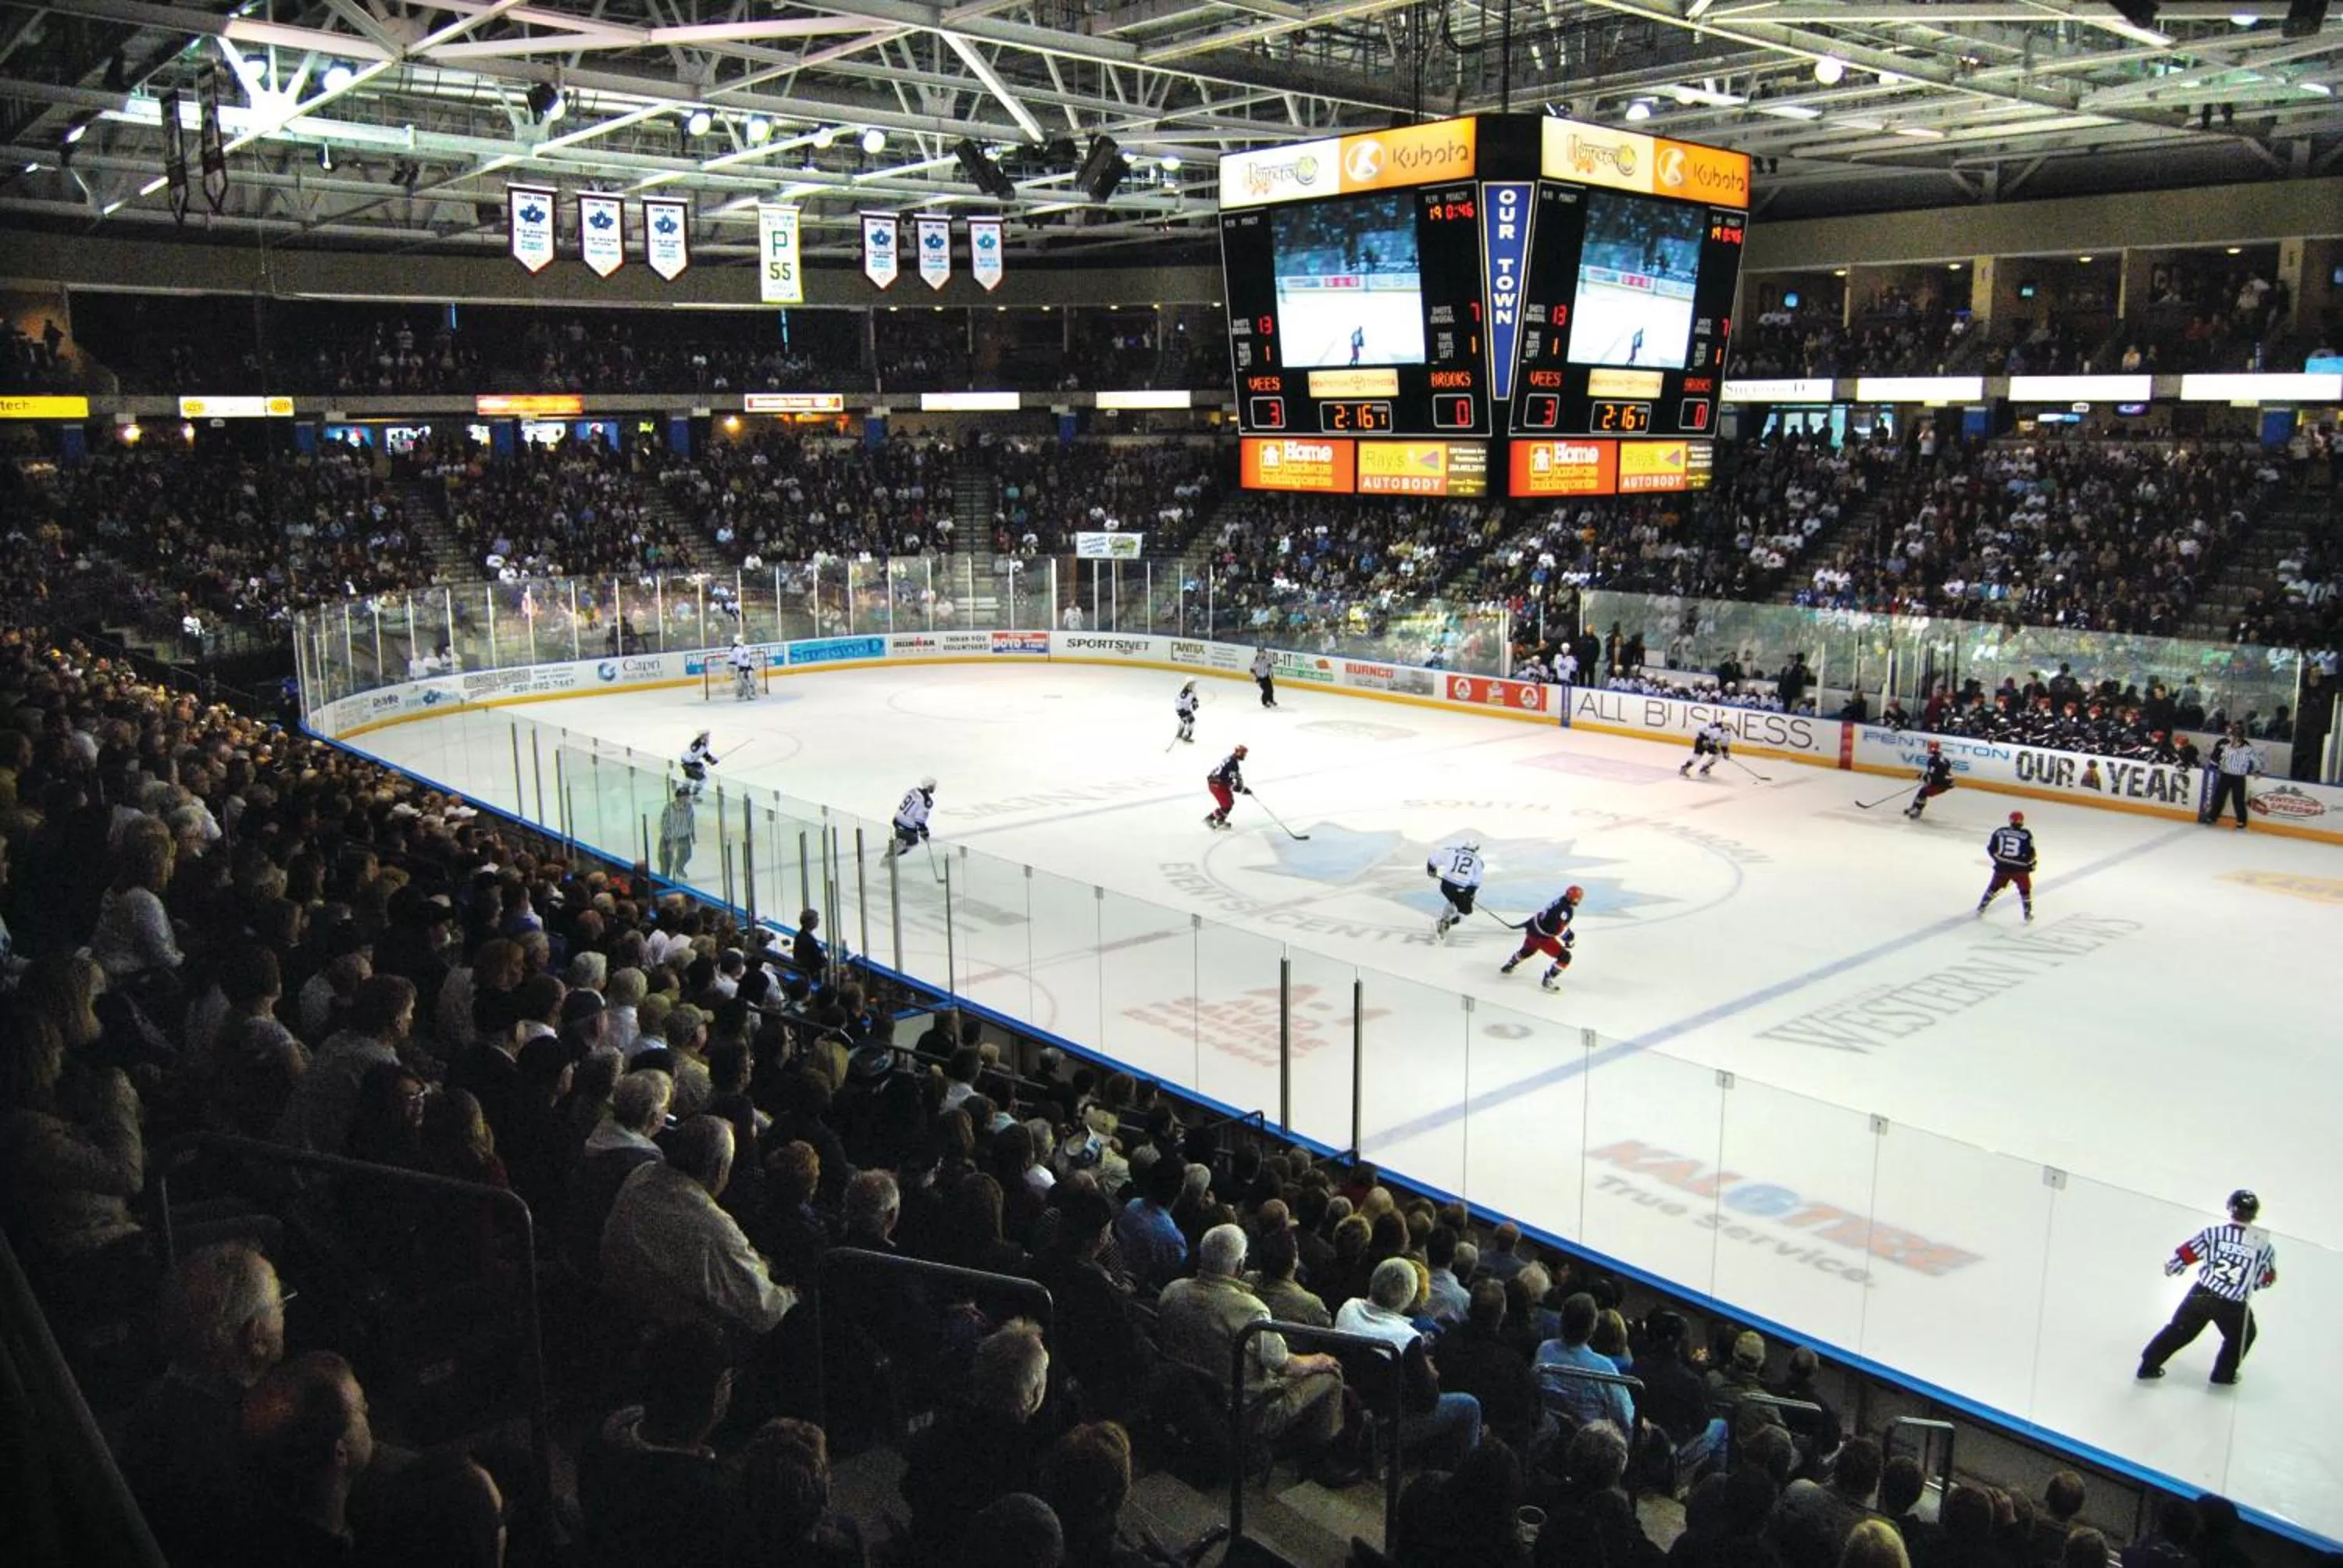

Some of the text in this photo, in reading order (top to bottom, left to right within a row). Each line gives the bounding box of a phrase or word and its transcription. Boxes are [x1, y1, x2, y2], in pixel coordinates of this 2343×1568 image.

[1393, 140, 1468, 169] Kubota
[1693, 161, 1745, 193] Kubota
[1430, 201, 1475, 220] 19 0:46
[1499, 189, 1517, 240] OUR
[772, 230, 789, 257] P
[770, 262, 792, 281] 55
[1493, 258, 1517, 324] TOWN
[1468, 301, 1482, 323] 7
[1552, 305, 1568, 326] 13
[1257, 315, 1274, 335] 13
[1248, 376, 1281, 390] VEES
[1430, 371, 1473, 388] BROOKS
[1529, 372, 1562, 387] VEES
[1269, 401, 1281, 426] 3
[1334, 404, 1375, 429] 2:16
[1455, 400, 1470, 426] 0
[1543, 400, 1556, 426] 3
[1602, 405, 1636, 430] 2:16
[1695, 402, 1706, 427] 0
[1283, 440, 1334, 462] Home
[1554, 443, 1599, 464] Home
[1363, 476, 1441, 491] AUTOBODY
[1622, 474, 1681, 490] AUTOBODY
[1066, 638, 1150, 651] SPORTSNET
[622, 658, 661, 673] Capri
[1345, 663, 1394, 679] BURNCO
[1578, 692, 1628, 723] ALL
[1863, 731, 2010, 761] PENTCTON
[1900, 753, 1970, 772] VES
[2016, 750, 2188, 805] OUR YEAR
[898, 794, 916, 818] 91
[1998, 835, 2021, 857] 13
[1450, 854, 1474, 875] 12
[1752, 956, 2038, 1055] WESTERN
[1594, 1174, 1878, 1288] True Service
[2213, 1258, 2243, 1285] 24
